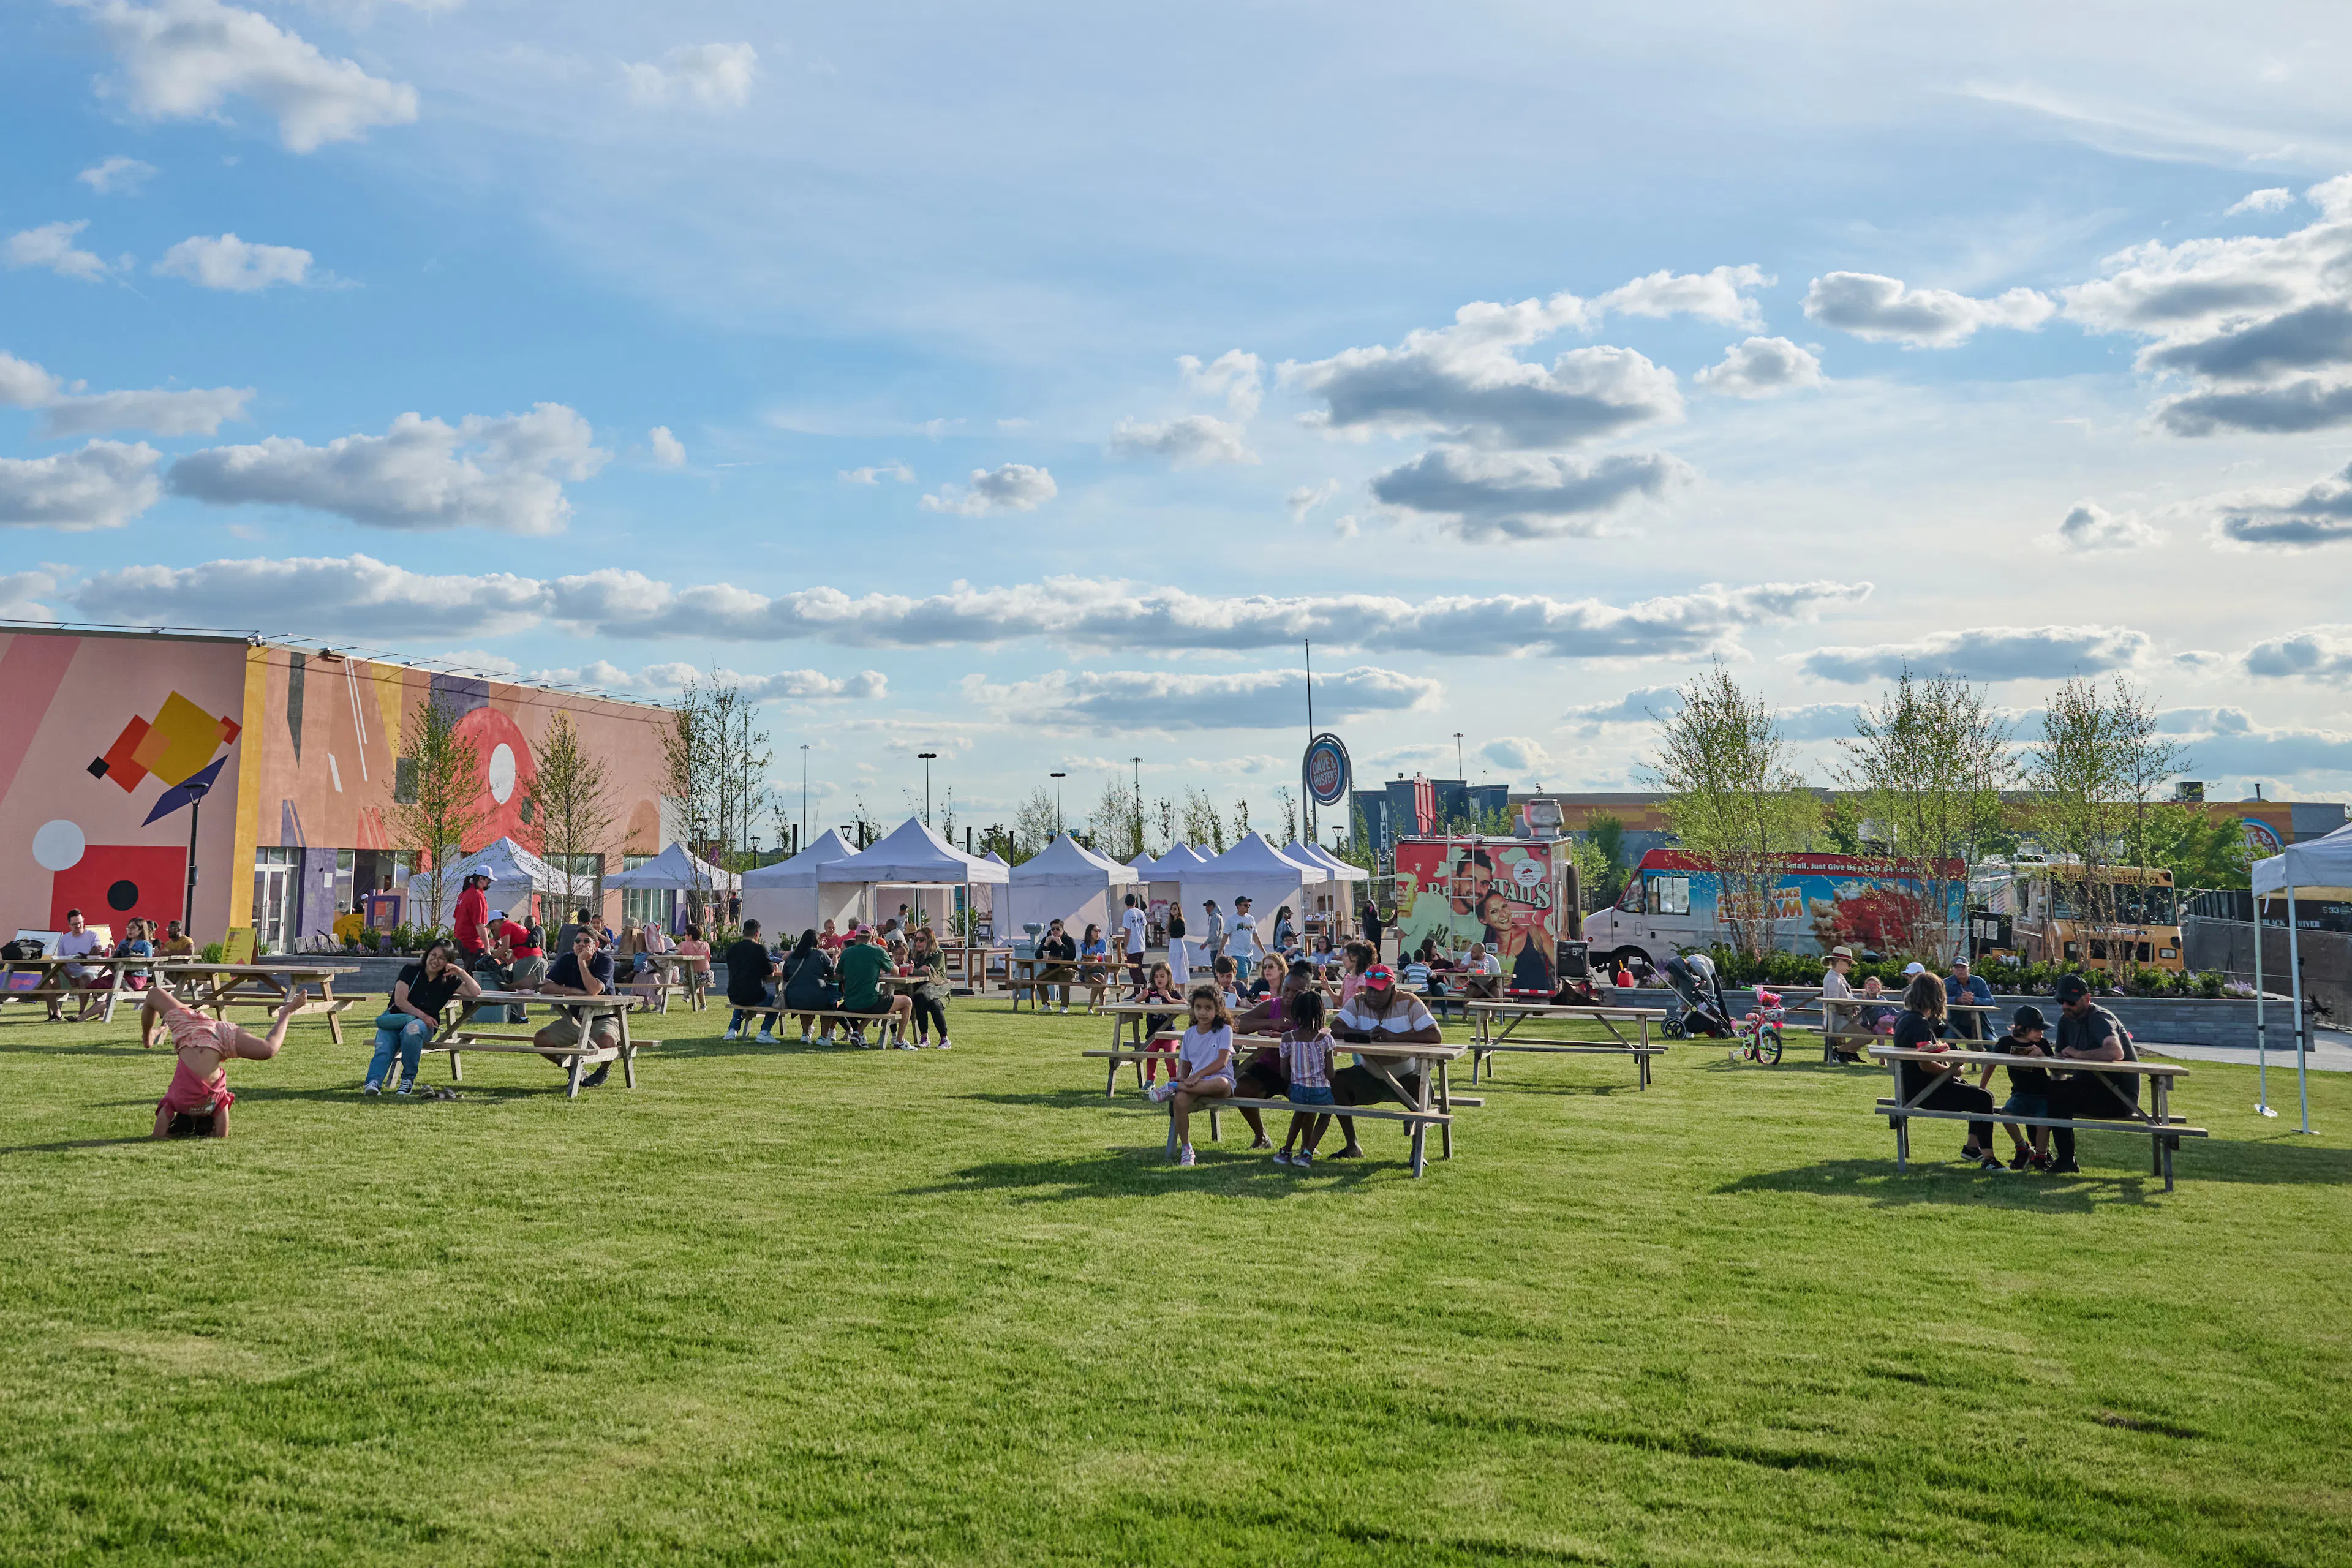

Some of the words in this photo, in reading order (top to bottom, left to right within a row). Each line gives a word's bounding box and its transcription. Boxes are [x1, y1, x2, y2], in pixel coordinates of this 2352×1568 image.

[1313, 757, 1331, 775] DAVE
[1330, 756, 1336, 769] &
[1313, 769, 1338, 786] BUSTER'S
[2259, 831, 2272, 844] &
